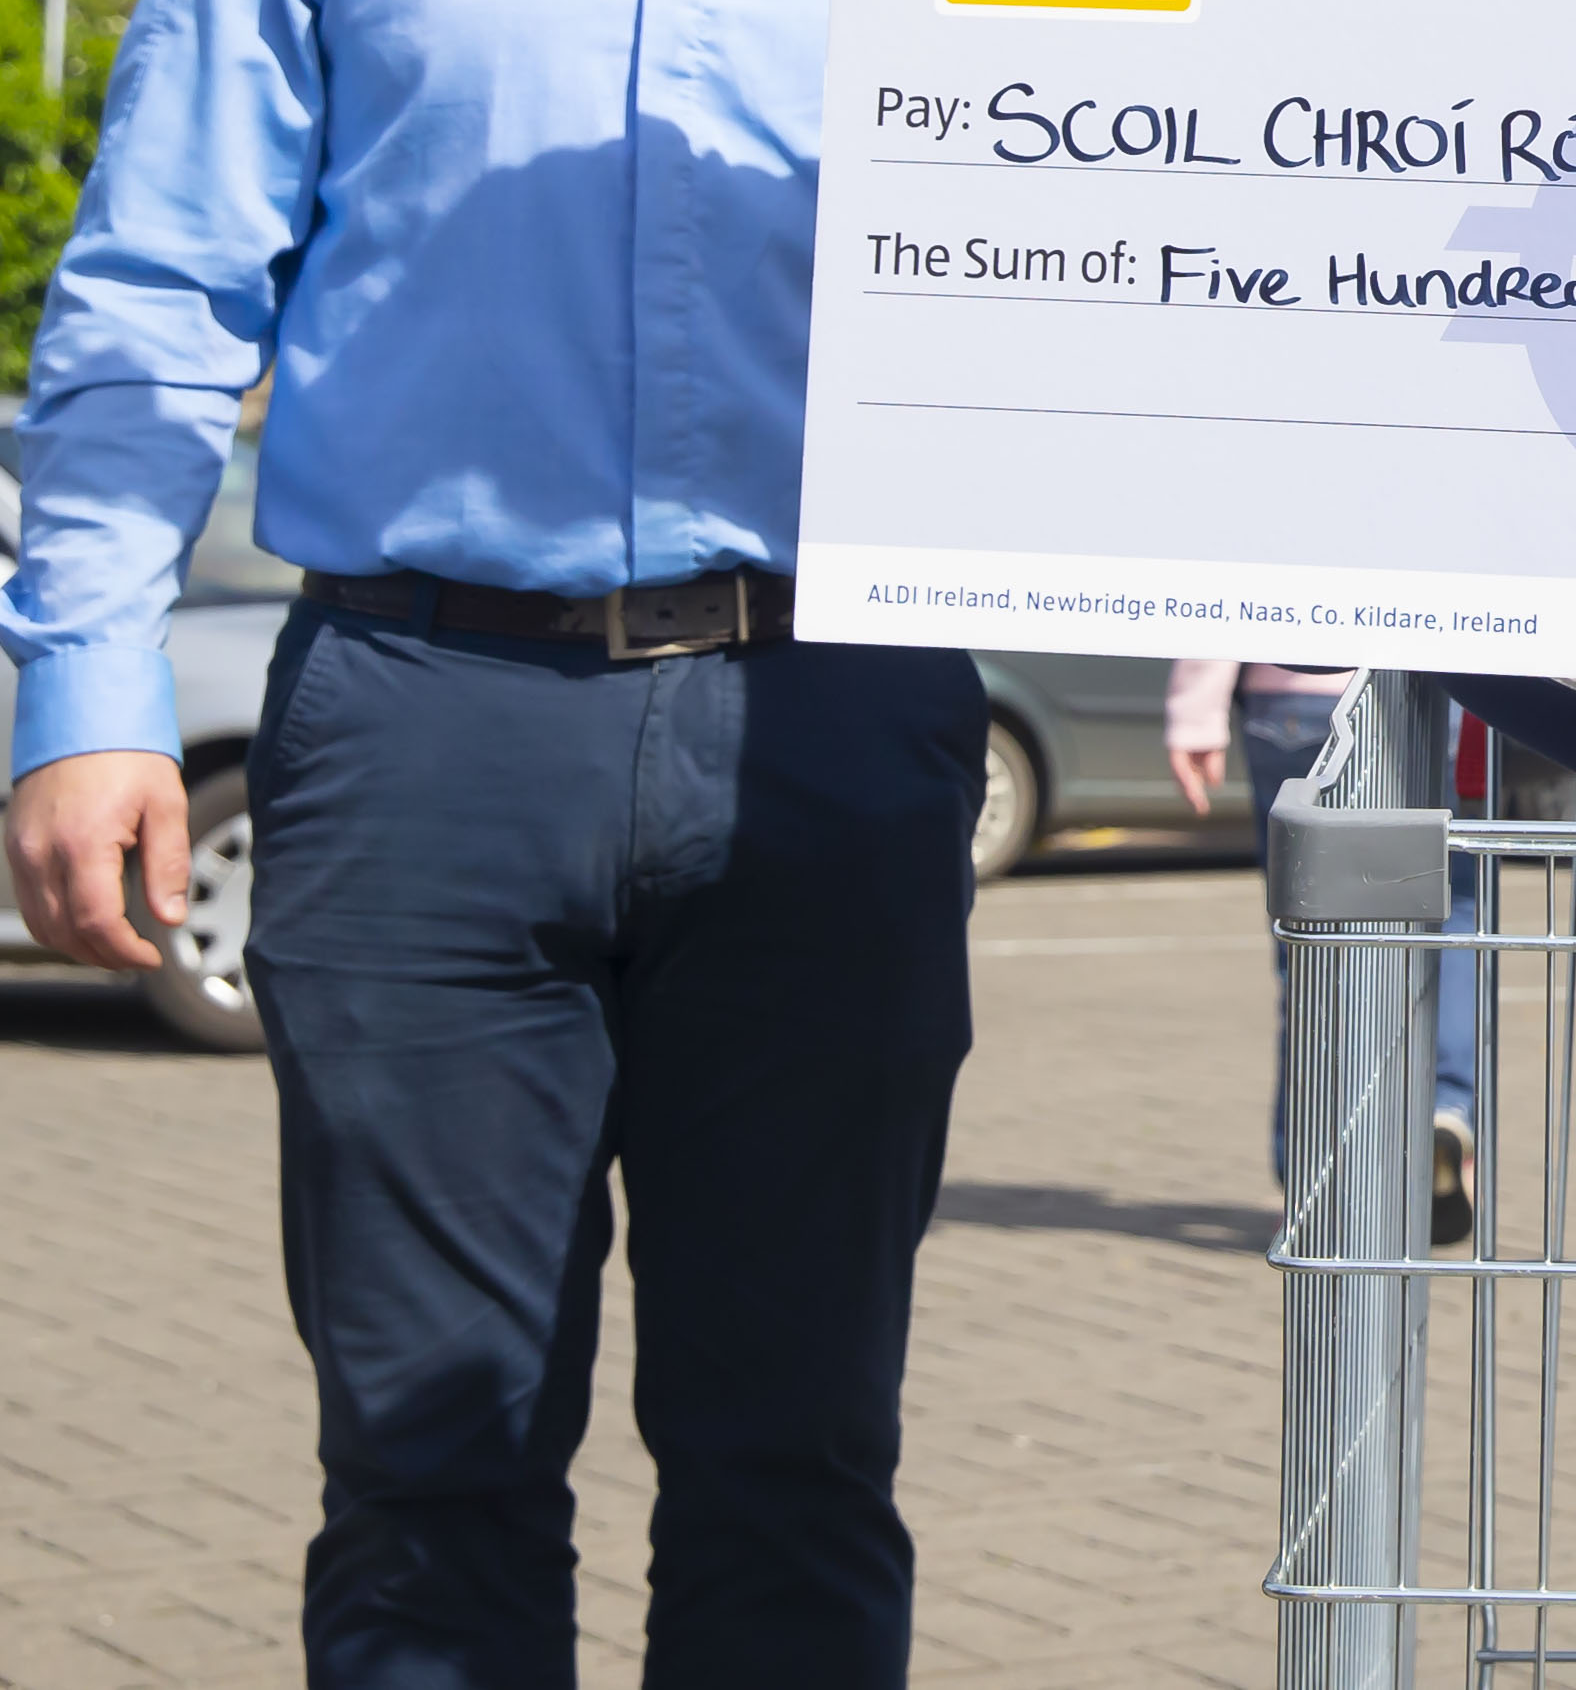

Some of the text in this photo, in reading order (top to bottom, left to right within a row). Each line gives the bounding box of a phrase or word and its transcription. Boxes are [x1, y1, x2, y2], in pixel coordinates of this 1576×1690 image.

[877, 87, 971, 141] Pay:
[987, 83, 1241, 164] SCOIL
[867, 232, 950, 278] The
[964, 238, 1066, 282] Sum
[1081, 240, 1136, 285] of:
[1160, 245, 1302, 306] Five
[867, 584, 1538, 635] ALDI Ireland, Newbridge Road, Naas, Co. Kildare, Ireland
